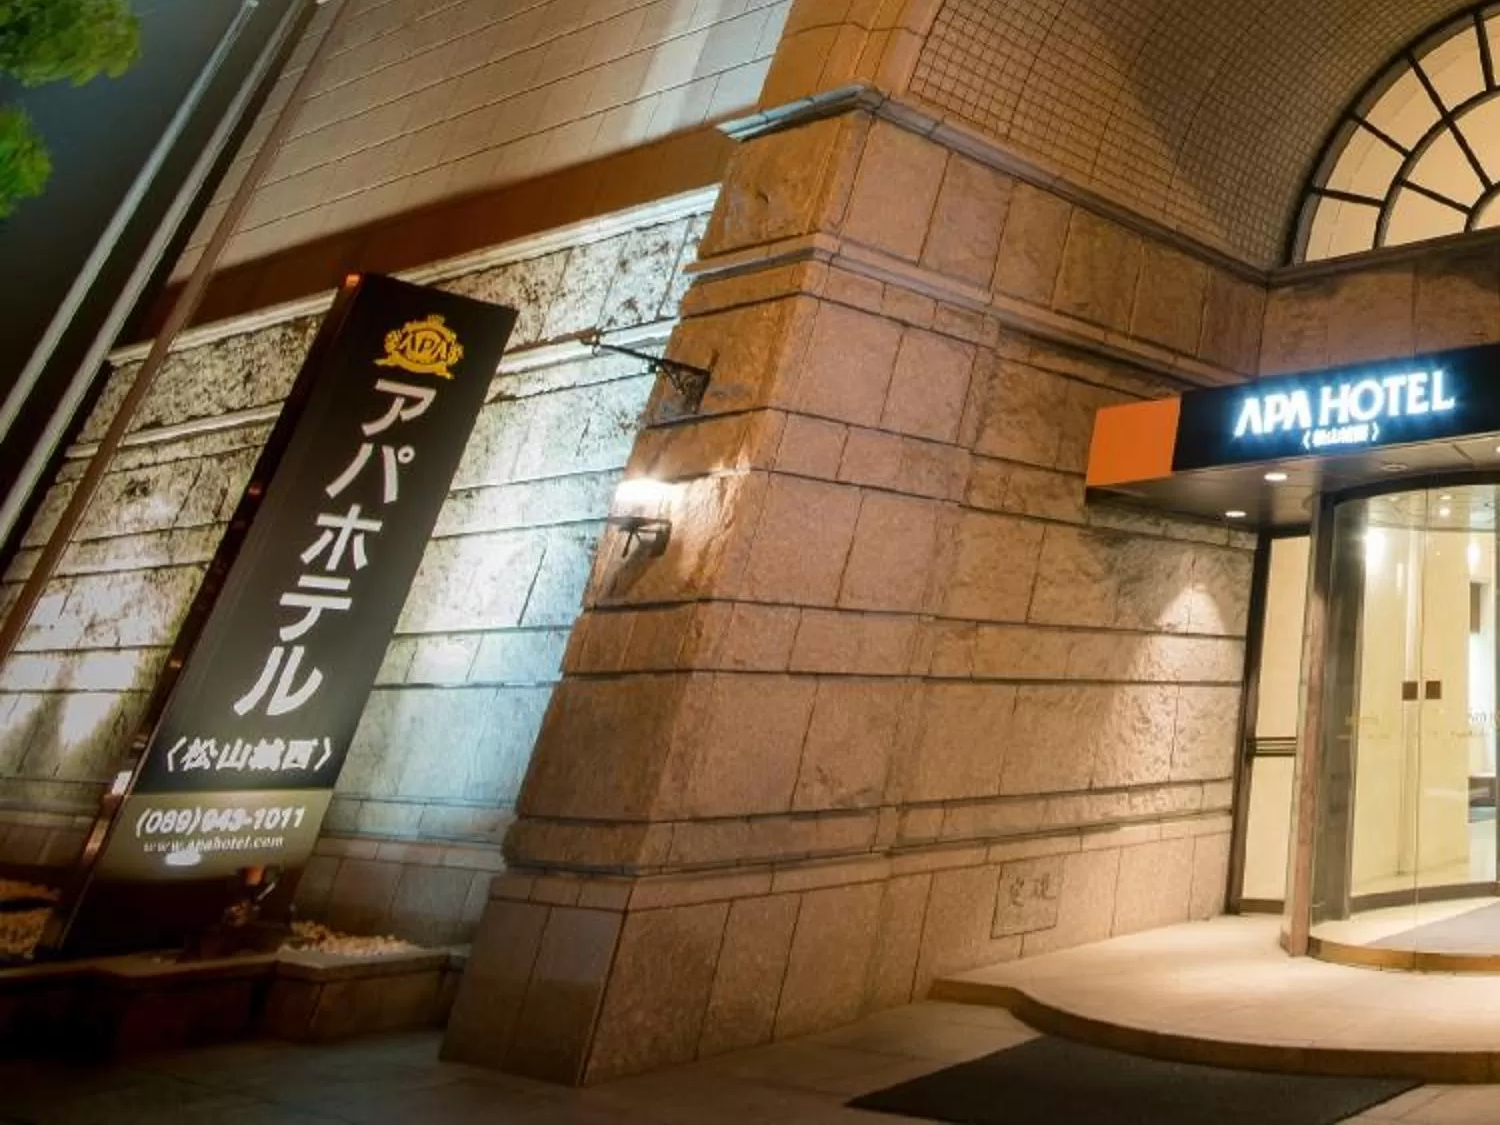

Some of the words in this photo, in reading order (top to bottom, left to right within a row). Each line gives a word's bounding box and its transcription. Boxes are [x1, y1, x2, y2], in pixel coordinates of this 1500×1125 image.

[1234, 390, 1312, 438] APA
[1318, 370, 1455, 427] HOTEL
[233, 378, 437, 717] アパホテル
